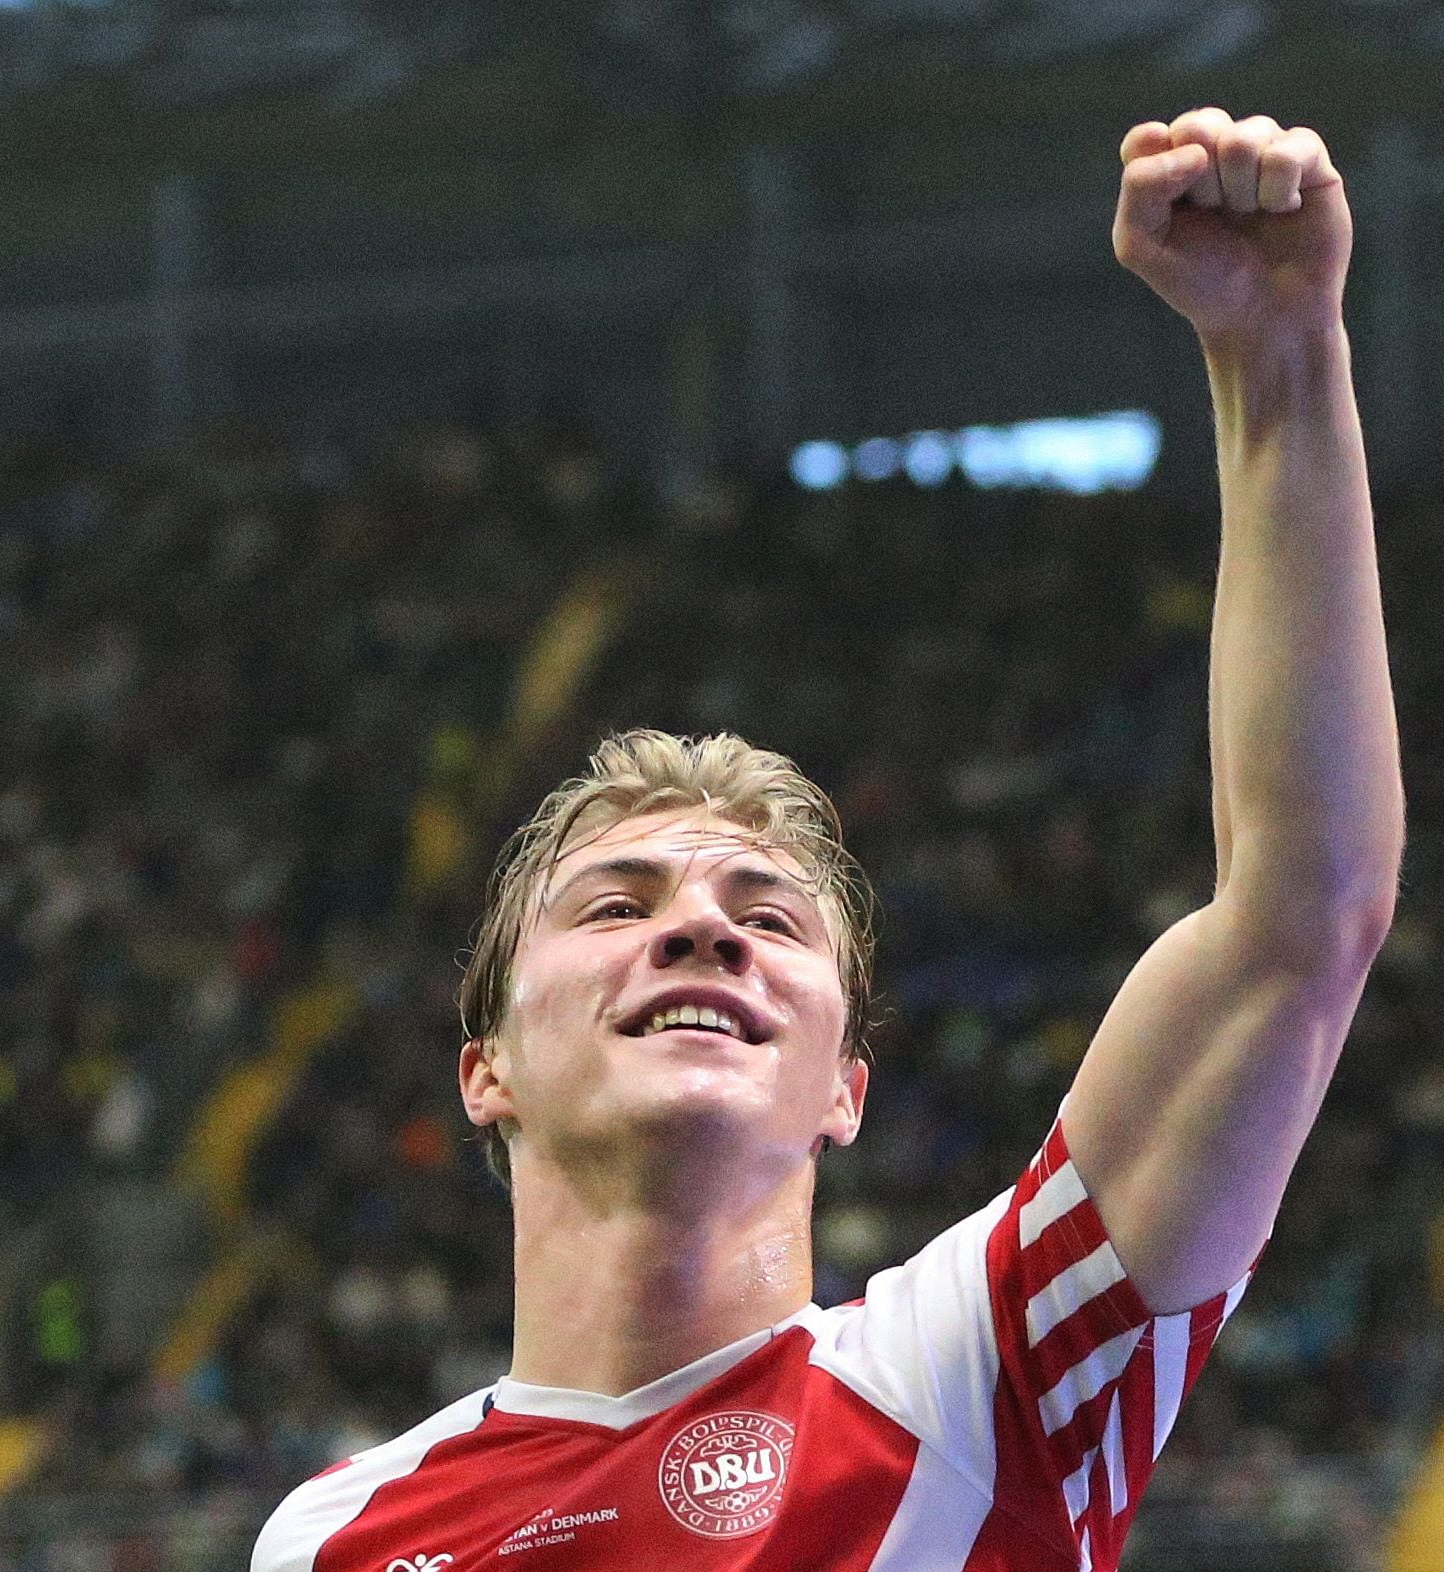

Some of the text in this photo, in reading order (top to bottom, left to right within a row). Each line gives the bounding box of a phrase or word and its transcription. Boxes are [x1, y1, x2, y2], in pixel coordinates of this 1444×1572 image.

[689, 1448, 776, 1495] DBU
[665, 1457, 705, 1526] DANSK
[551, 1507, 619, 1531] DENMARK
[498, 1541, 534, 1556] ASTANA
[534, 1532, 576, 1548] STADIUM
